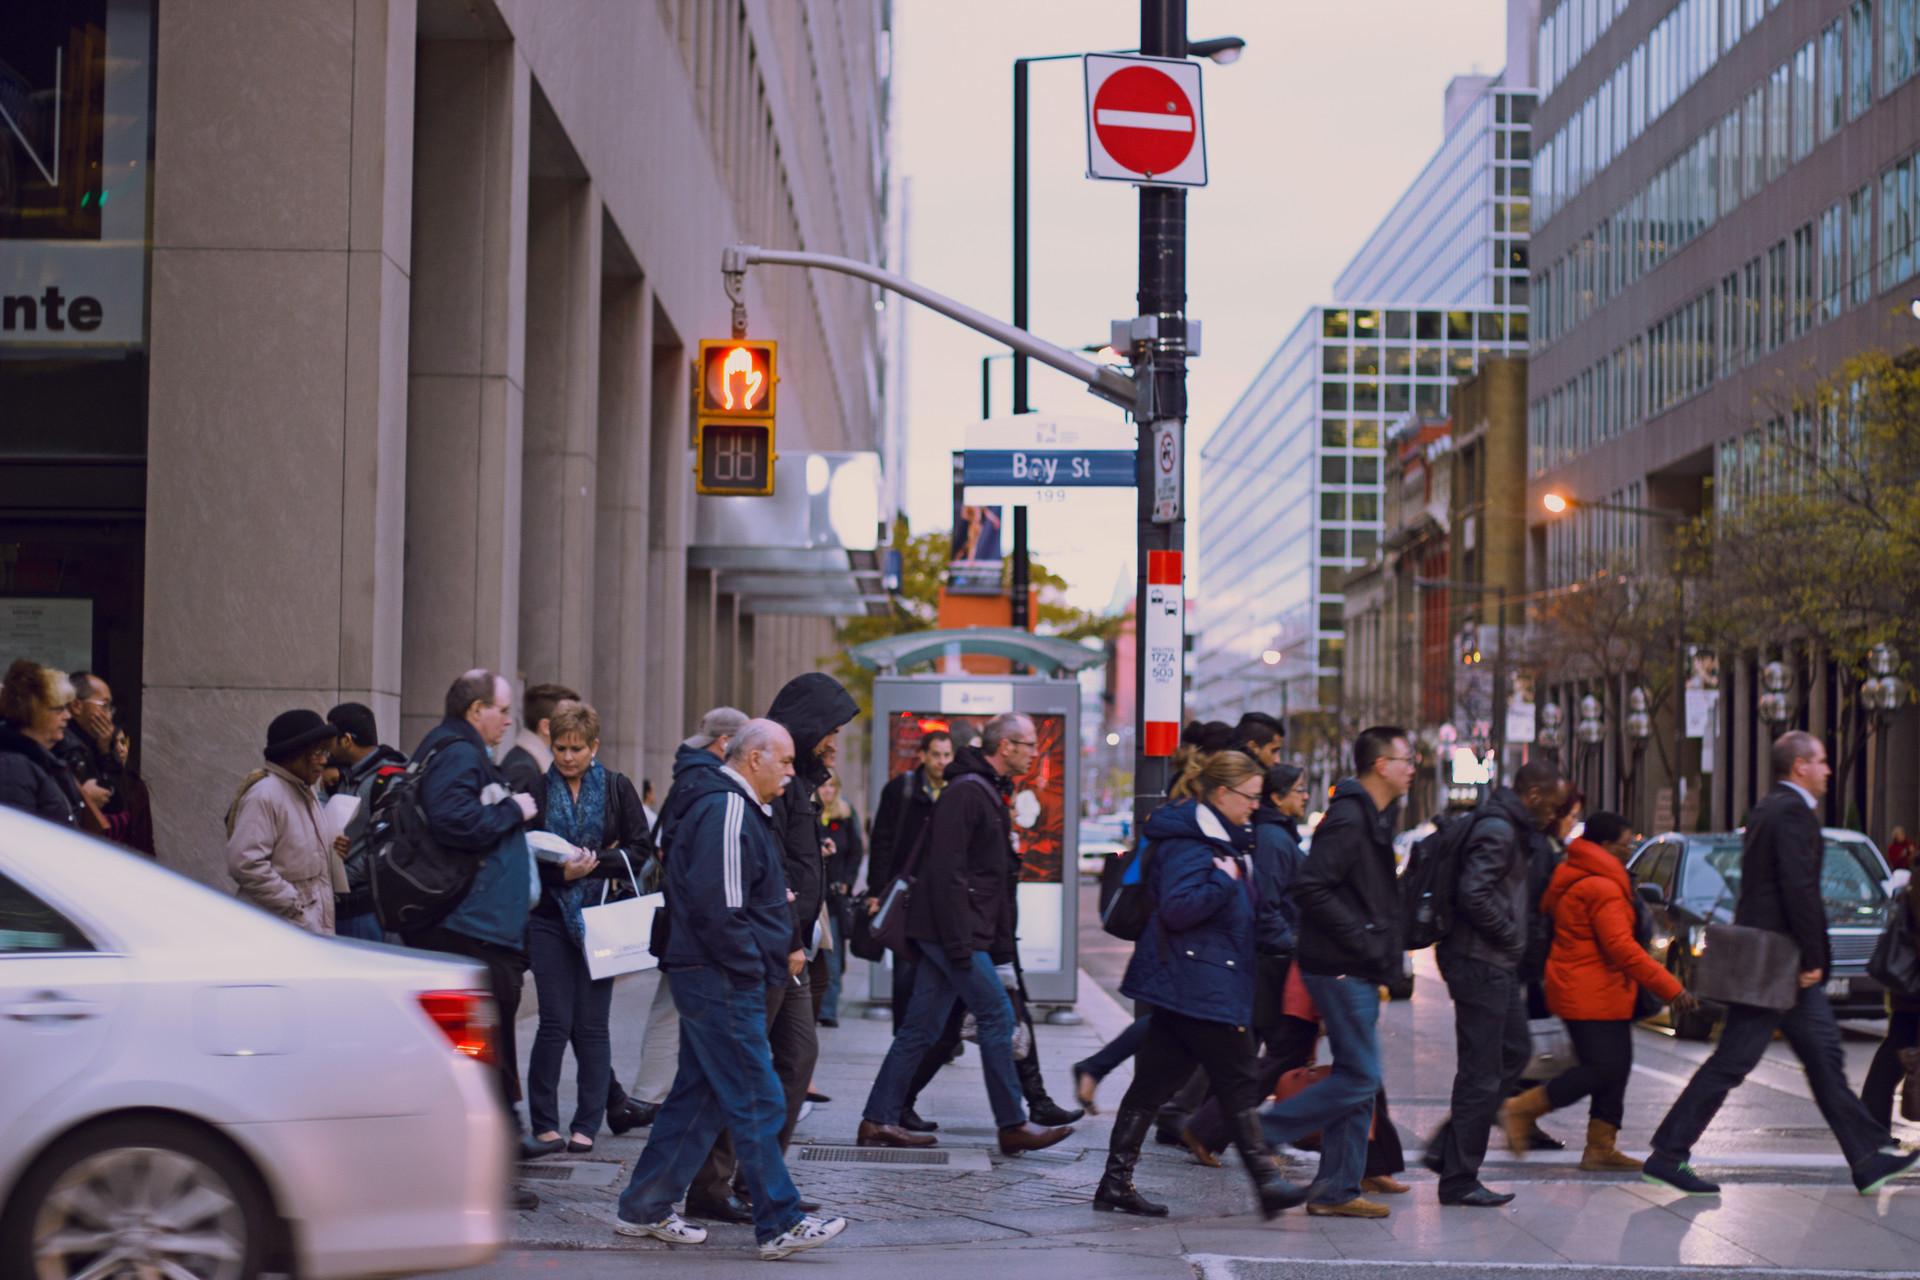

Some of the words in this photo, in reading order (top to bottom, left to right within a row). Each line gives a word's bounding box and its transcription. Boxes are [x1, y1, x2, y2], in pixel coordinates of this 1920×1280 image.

[1012, 453, 1058, 484] Bay
[1072, 457, 1091, 478] St
[1037, 489, 1066, 502] 199
[1152, 653, 1175, 662] 172A
[1152, 668, 1174, 678] 503
